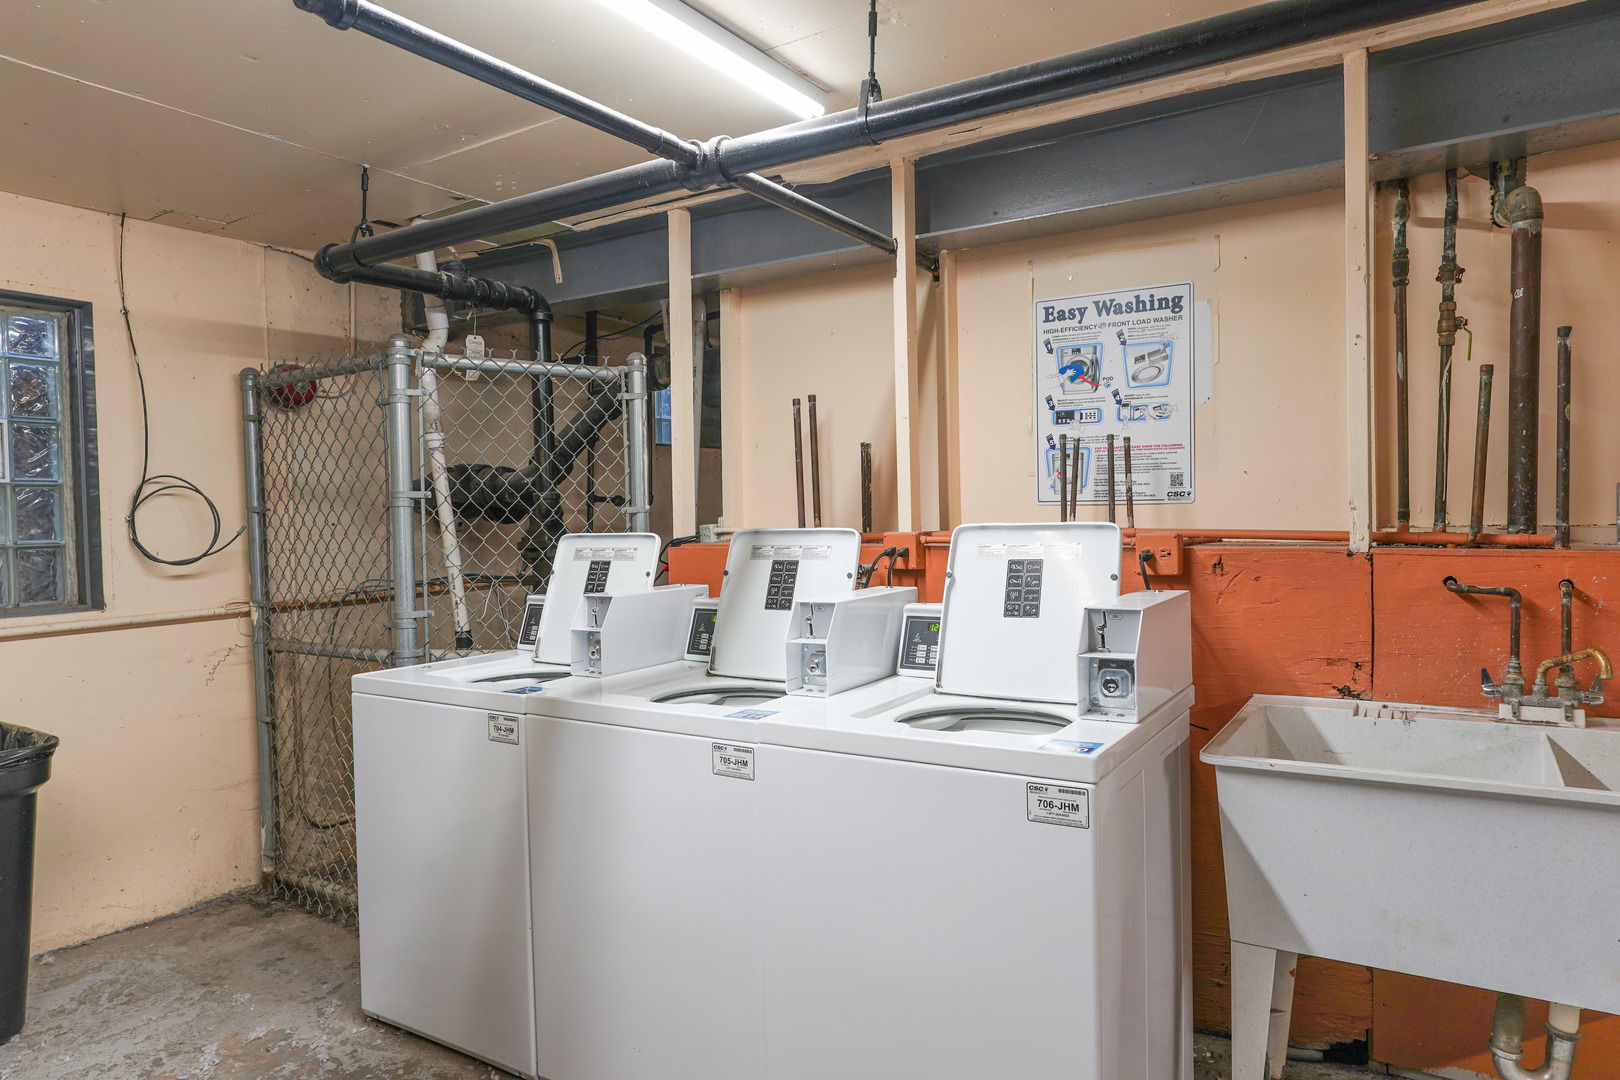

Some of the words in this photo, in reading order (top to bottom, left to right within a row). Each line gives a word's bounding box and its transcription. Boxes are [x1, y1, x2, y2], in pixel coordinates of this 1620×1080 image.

[1042, 305, 1088, 324] Easy
[1092, 294, 1184, 318] Washing
[1043, 323, 1098, 335] HIGH-EFFICIENCY
[1108, 320, 1131, 328] FRONT
[1132, 318, 1152, 326] LOAD
[1153, 315, 1184, 323] WASHER
[493, 724, 514, 733] 704-JHM
[719, 756, 749, 767] 705-JHM
[1037, 798, 1080, 813] 706-JHM
